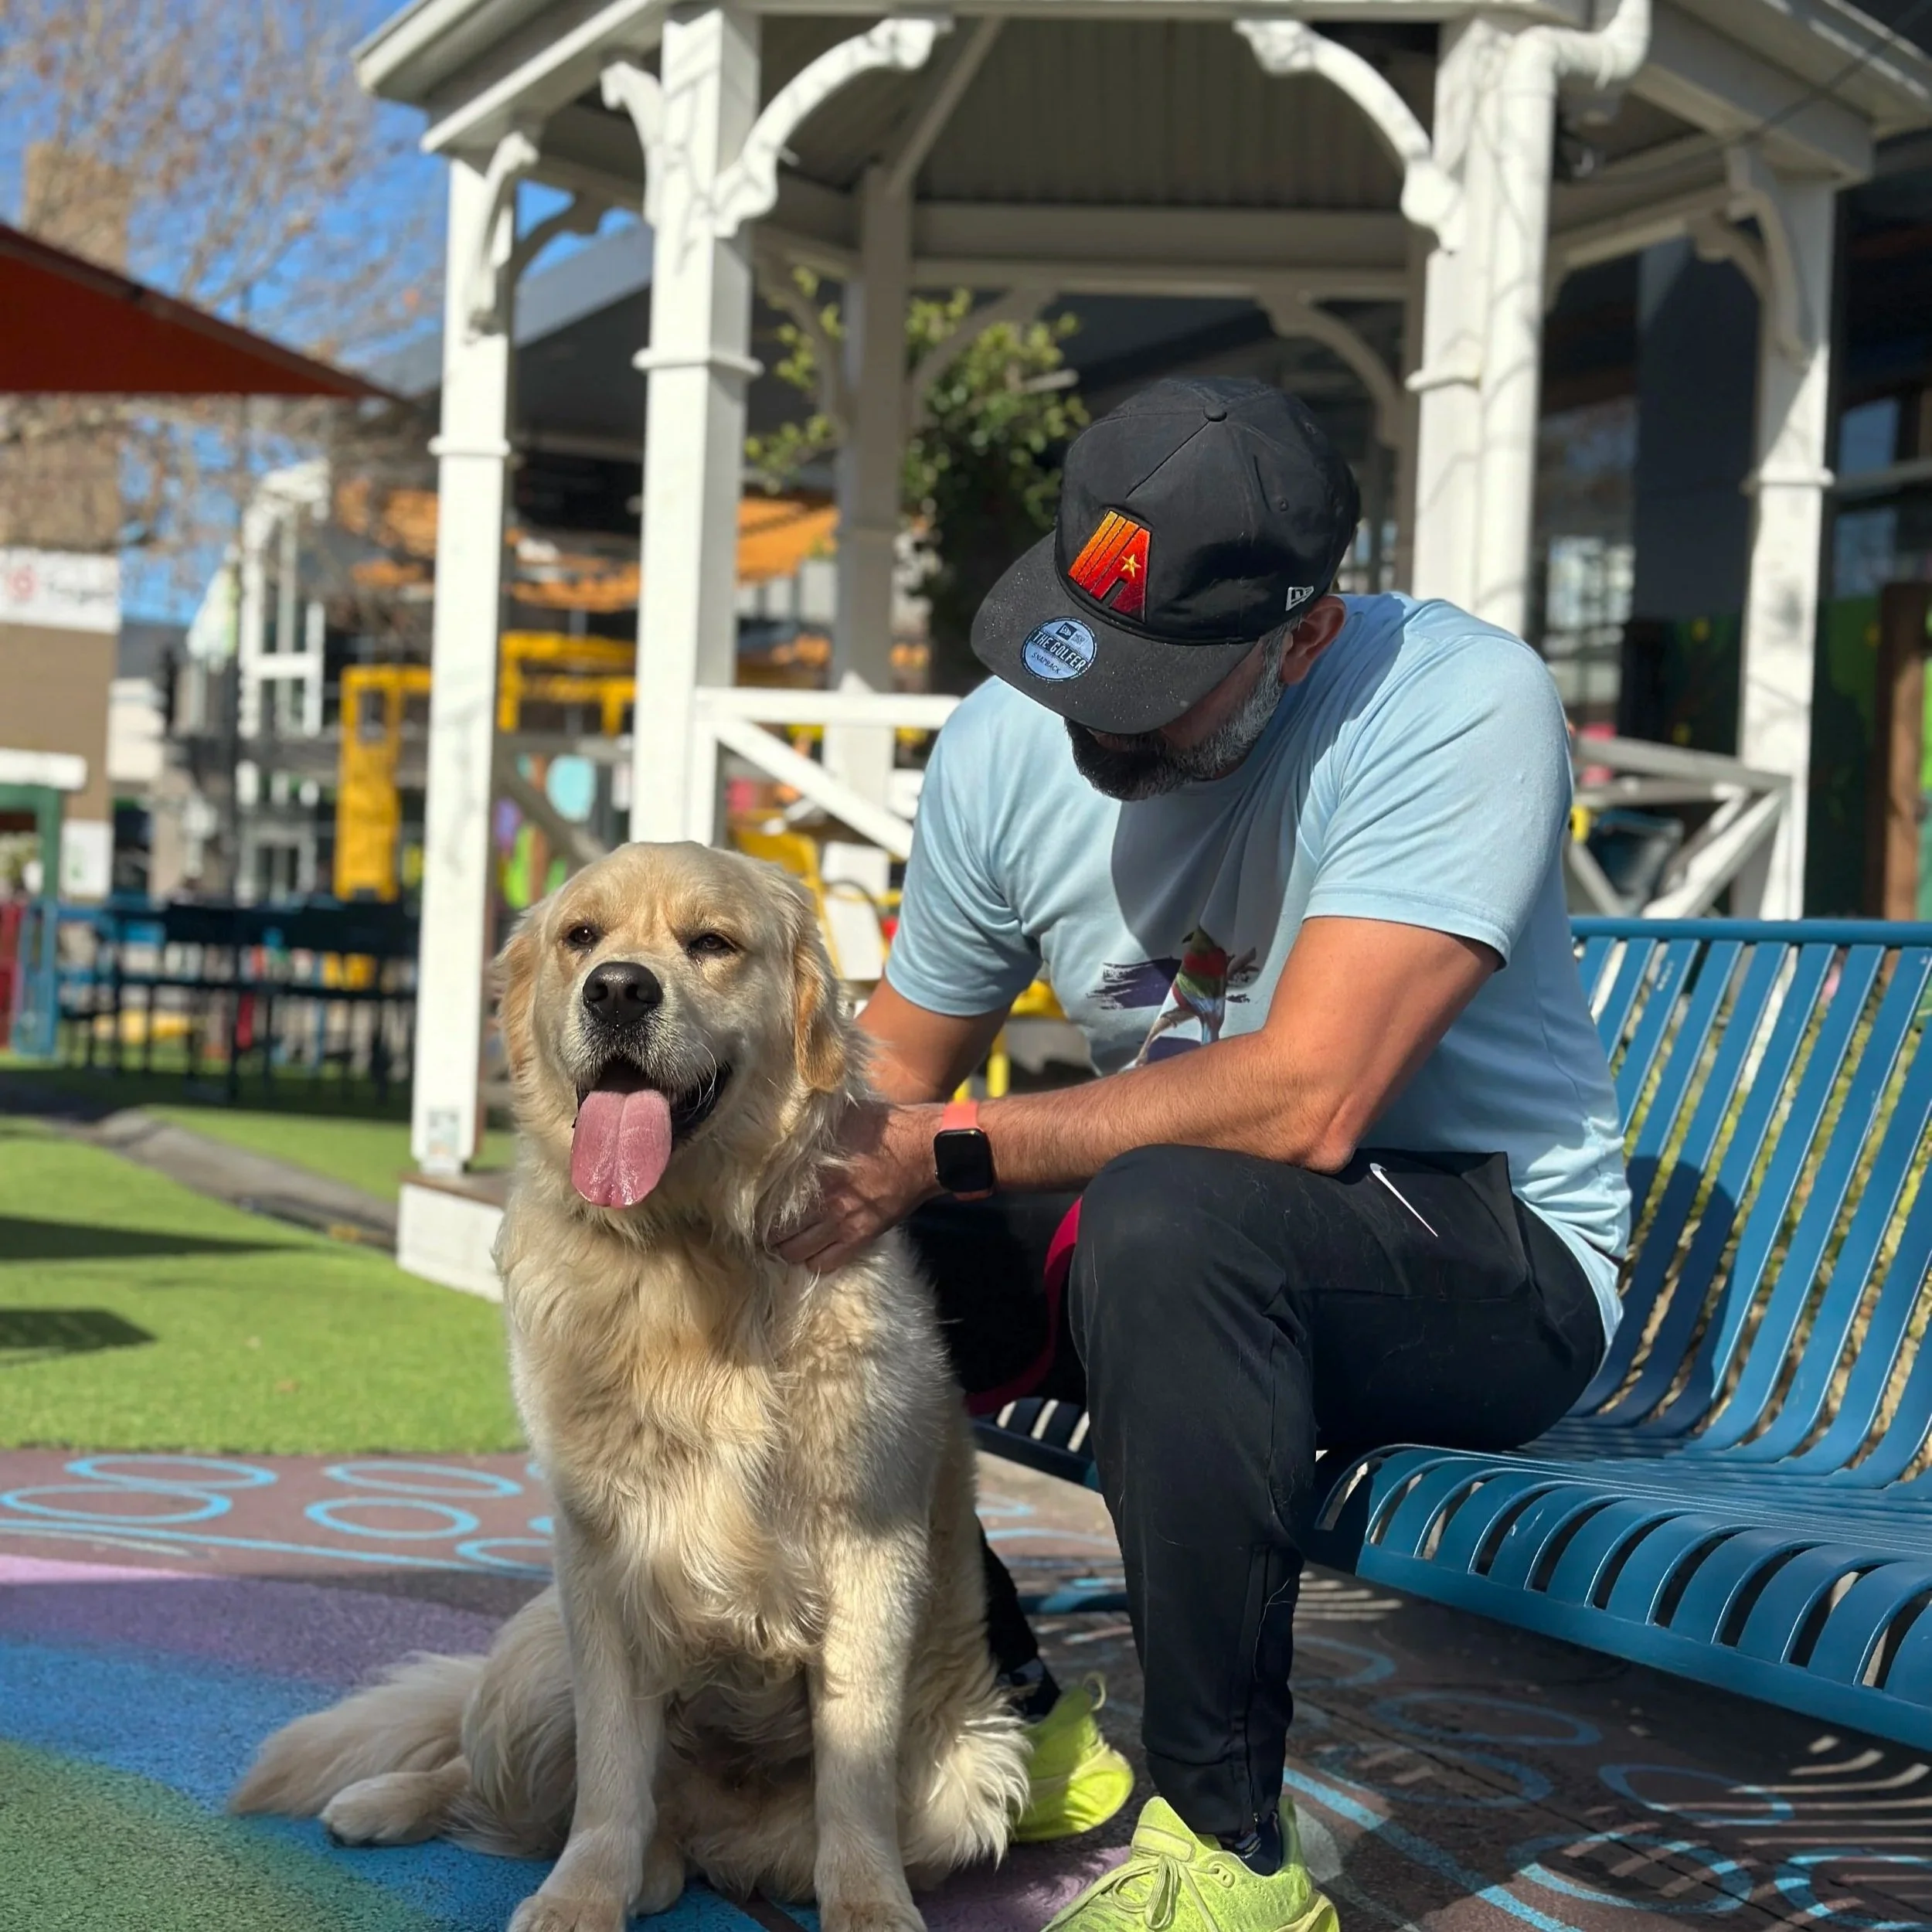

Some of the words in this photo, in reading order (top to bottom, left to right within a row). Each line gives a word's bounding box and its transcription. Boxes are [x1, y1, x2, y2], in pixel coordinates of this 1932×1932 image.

[1032, 652, 1061, 674] SNAPBACK
[1033, 631, 1053, 648] THE
[1049, 641, 1087, 671] GOLFER
